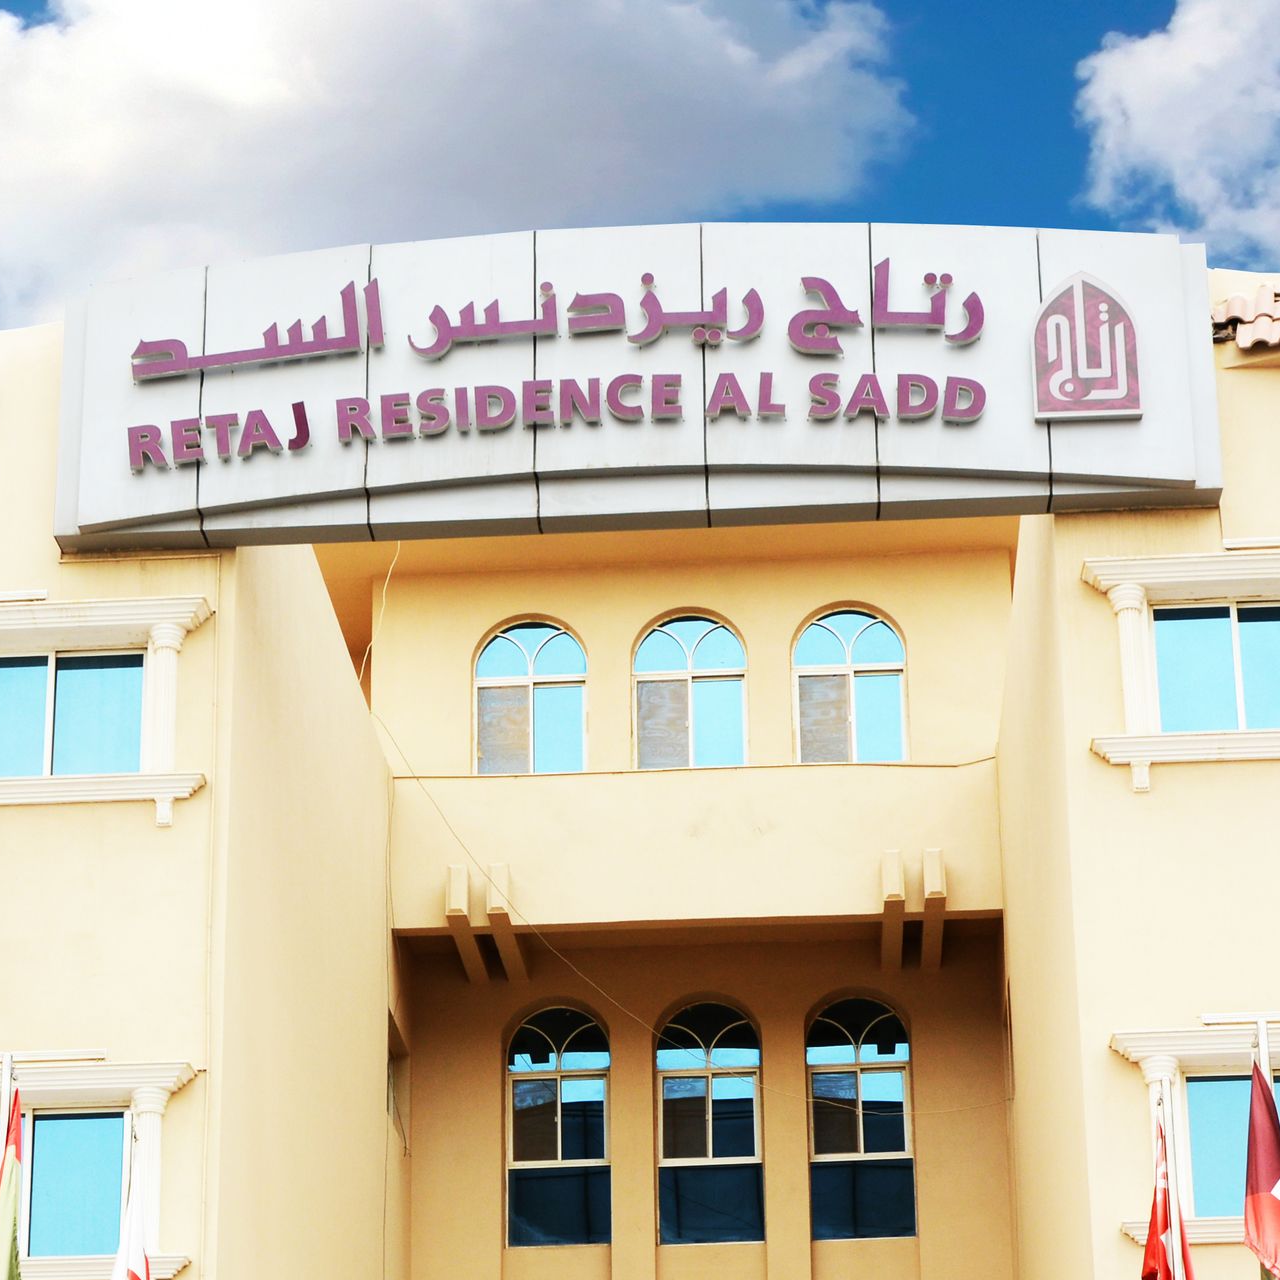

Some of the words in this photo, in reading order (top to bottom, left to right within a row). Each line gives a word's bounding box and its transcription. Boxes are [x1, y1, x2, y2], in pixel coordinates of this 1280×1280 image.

[130, 277, 385, 382] السد
[407, 272, 765, 361] ريزدنس
[787, 257, 985, 355] رتاج
[126, 400, 312, 472] RETAJ
[335, 374, 683, 444] RESIDENCE
[705, 372, 786, 418] AL
[808, 373, 987, 423] SADD
